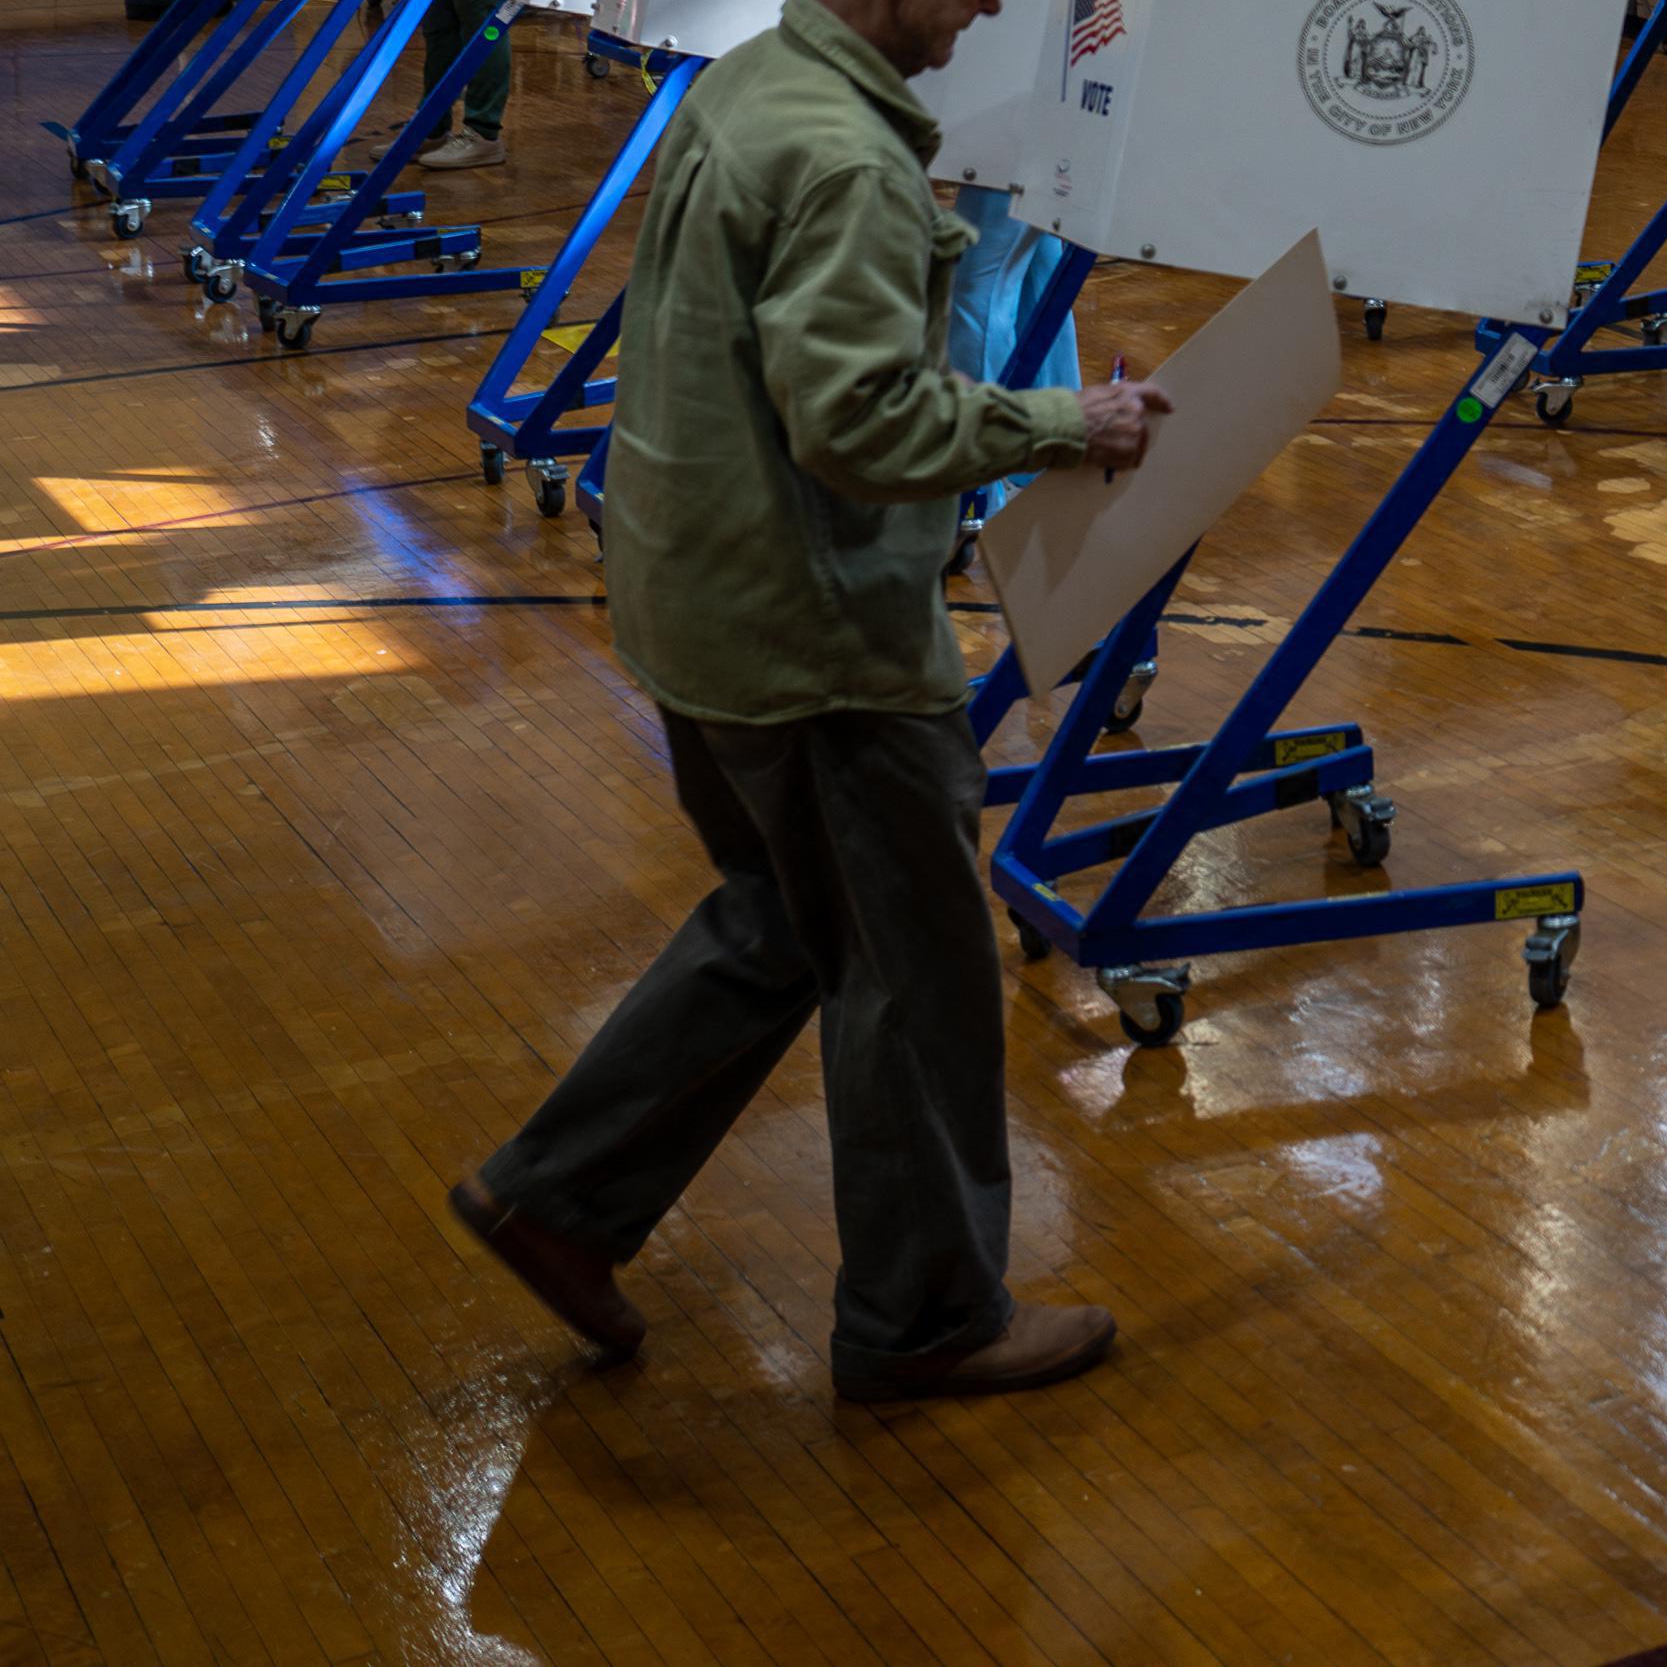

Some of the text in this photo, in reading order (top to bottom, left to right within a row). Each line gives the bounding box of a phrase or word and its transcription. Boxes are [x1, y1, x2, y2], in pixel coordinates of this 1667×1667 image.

[1081, 78, 1113, 116] VOTE
[1307, 48, 1463, 135] IN THE CITY OF NEW YORK
